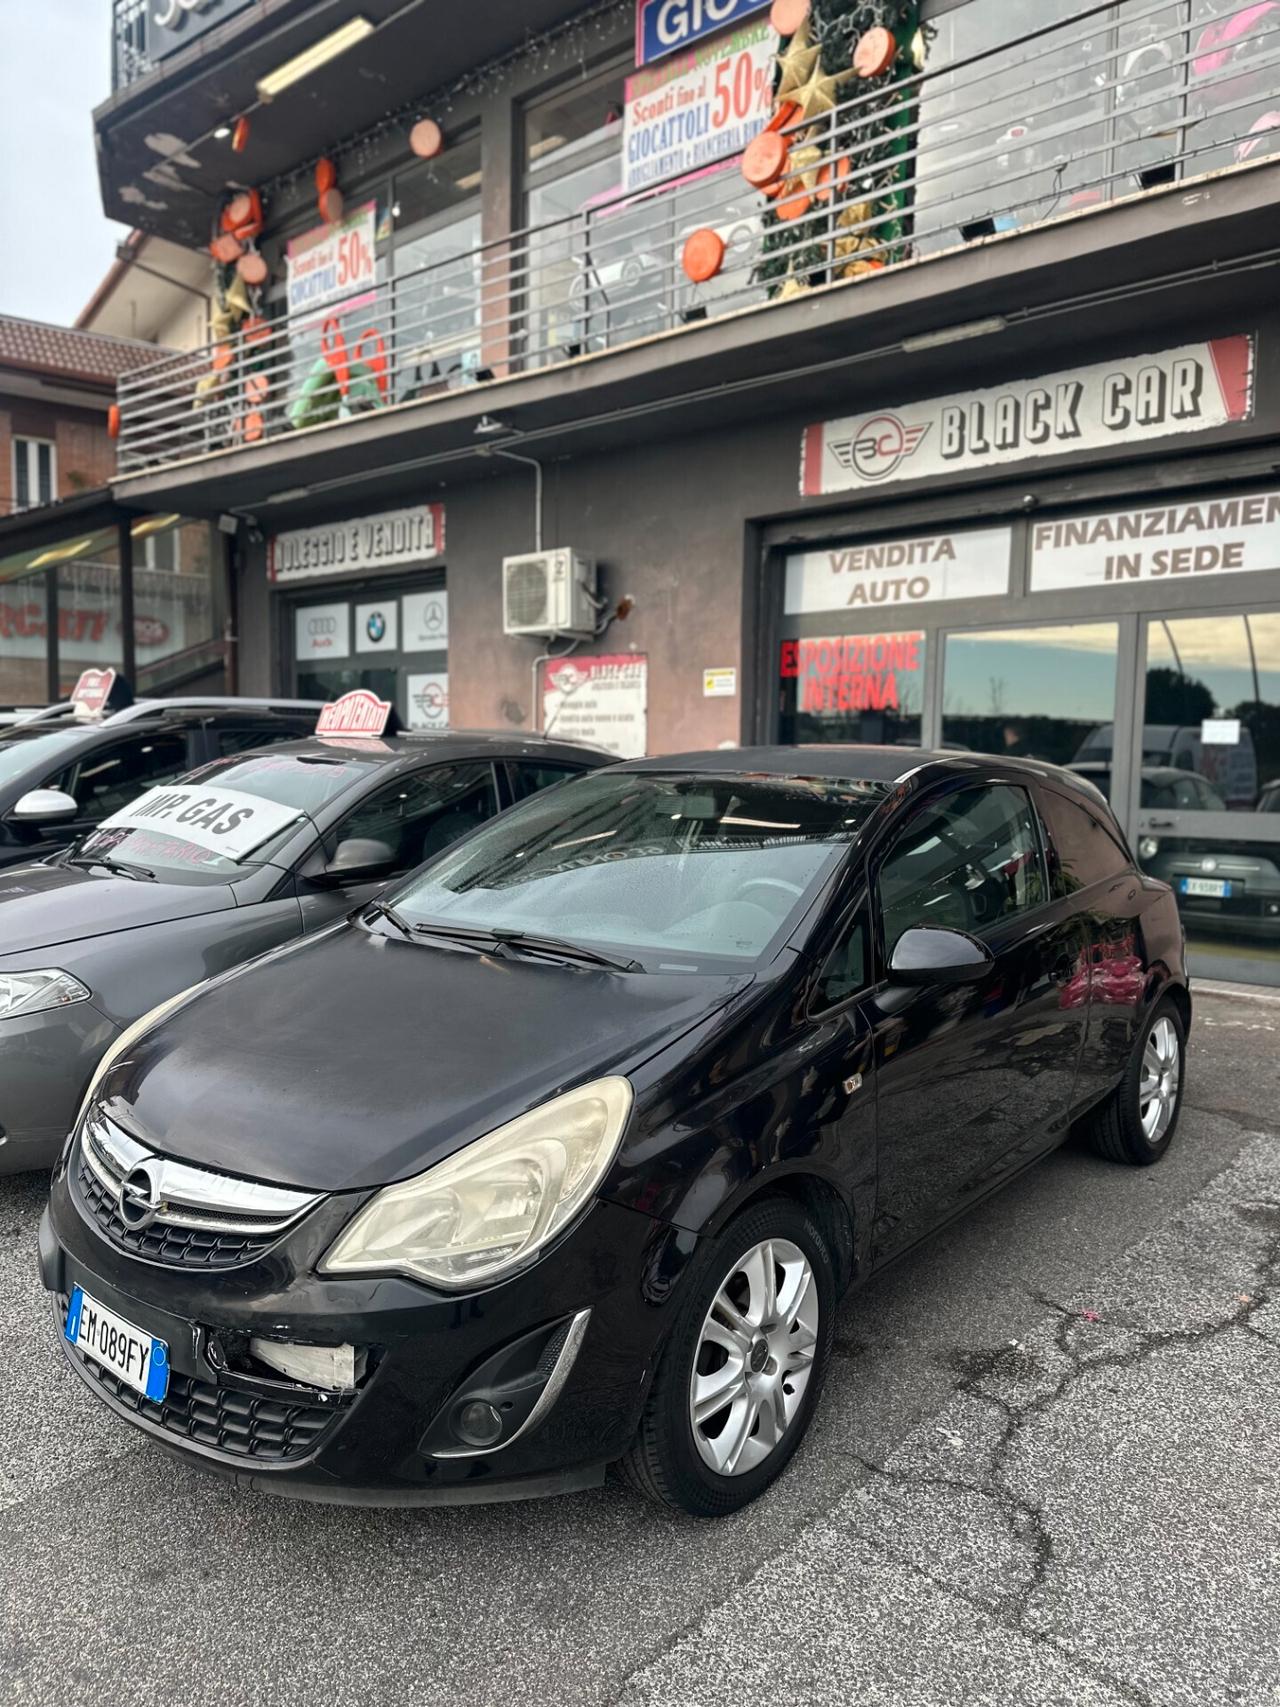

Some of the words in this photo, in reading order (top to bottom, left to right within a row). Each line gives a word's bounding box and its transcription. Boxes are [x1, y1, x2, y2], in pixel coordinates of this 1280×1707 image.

[657, 0, 760, 45] GIO
[632, 87, 675, 126] Sconti
[712, 52, 772, 128] 50%
[628, 102, 709, 163] GIOCATTOLI
[337, 230, 372, 286] 50%
[940, 381, 1084, 460] BLACK
[1102, 358, 1203, 431] CAR
[365, 511, 435, 559] VENDITA
[829, 538, 956, 574] VENDITA
[1104, 553, 1142, 581] IN
[1150, 541, 1245, 576] SEDE
[847, 576, 930, 605] AUTO
[780, 633, 921, 678] ESPOSIZIONE
[801, 671, 899, 712] INTERNA
[176, 798, 254, 834] GAS
